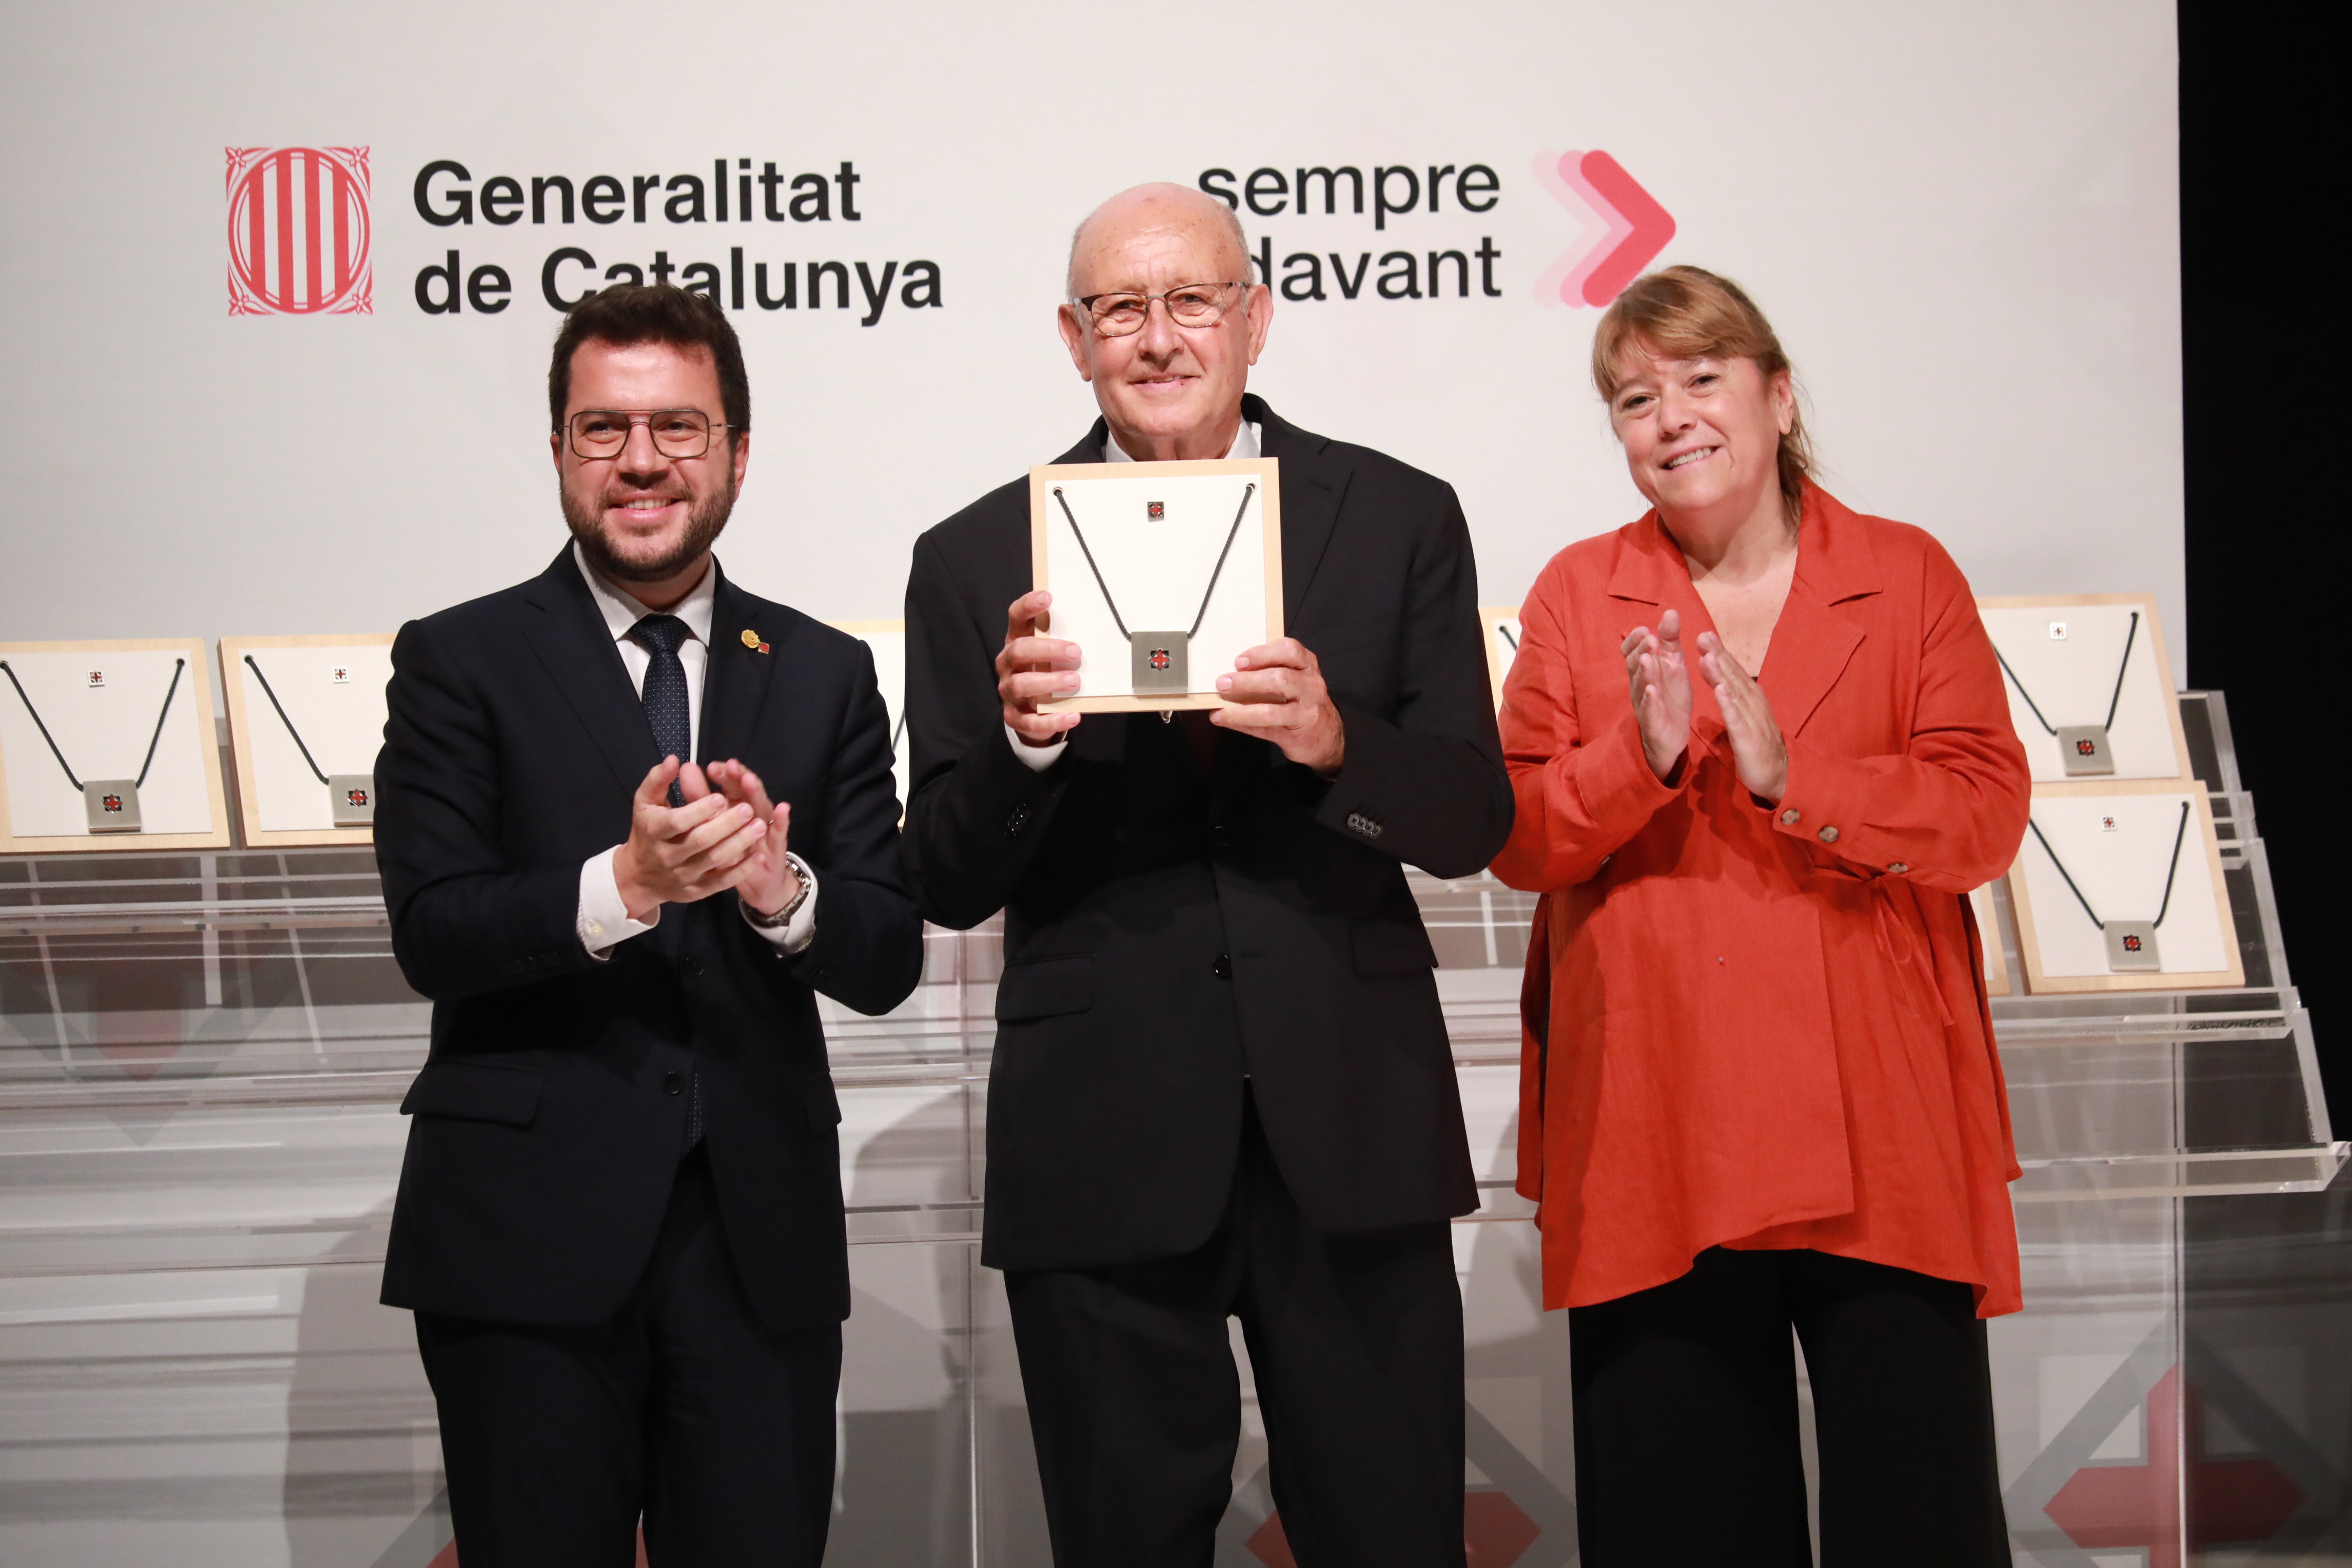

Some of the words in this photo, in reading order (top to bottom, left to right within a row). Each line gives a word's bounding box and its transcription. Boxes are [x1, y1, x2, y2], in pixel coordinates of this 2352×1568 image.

[414, 159, 861, 227] Generalitat
[1198, 164, 1500, 231] sempre
[414, 249, 512, 315] de
